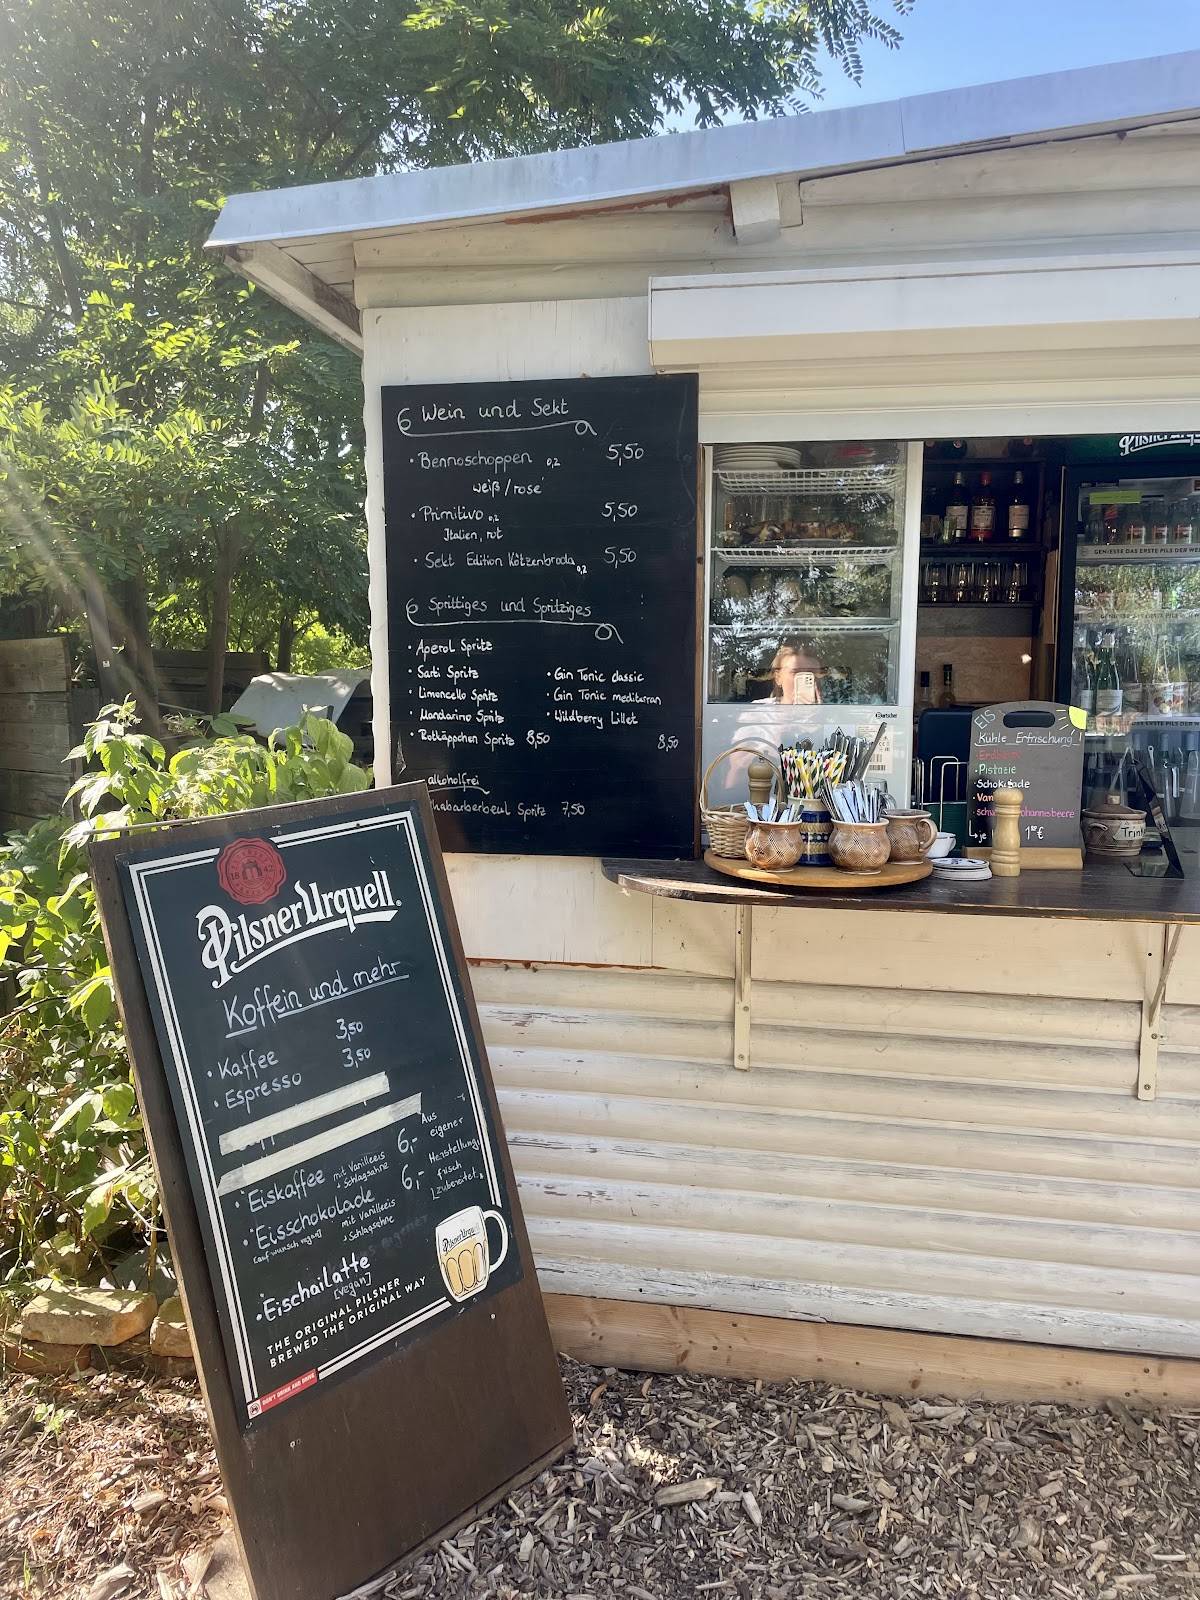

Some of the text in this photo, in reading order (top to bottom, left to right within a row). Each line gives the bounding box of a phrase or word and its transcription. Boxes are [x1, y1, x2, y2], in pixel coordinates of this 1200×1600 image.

[421, 398, 569, 422] Wein und Sekt
[417, 443, 645, 474] Bennoschoppen 0,2 5,50
[418, 505, 484, 522] Primitivo
[601, 502, 638, 522] 5,50
[443, 527, 503, 542] Italien, rot
[425, 552, 455, 568] Sekt
[466, 552, 503, 567] Edition
[603, 547, 637, 568] 5,50
[501, 598, 526, 613] und
[533, 597, 592, 621] Spritziges
[416, 638, 493, 662] Aperol Spritz
[447, 666, 480, 685] Spritz
[554, 667, 645, 683] Gin Tonic classic
[418, 685, 499, 707] Limoncello Spritz
[553, 686, 662, 706] Gin Tonic mediterran
[419, 708, 505, 727] Mandarino Spritz
[554, 709, 639, 730] Wildberry Lillet
[974, 709, 996, 730] EIS
[484, 731, 515, 752] Spritz
[526, 729, 551, 750] 8,50
[657, 733, 679, 752] 8,50
[978, 731, 1073, 748] Kühle Erfrischung
[979, 763, 1017, 775] Pistazie
[427, 772, 480, 792] alkoholfrei
[431, 799, 586, 822] habarberbeul Spritz 7,50
[1020, 807, 1076, 819] ohannisbeere
[978, 830, 988, 844] je
[195, 871, 396, 989] Pilsner Urquell
[222, 956, 401, 1030] Koffein und mehr
[217, 1018, 364, 1081] Kaffee 3,50
[225, 1048, 371, 1114] Espresso 3,50
[421, 1112, 437, 1125] Aus
[430, 1117, 464, 1138] eigener
[436, 1160, 463, 1181] frisch
[248, 1168, 326, 1213] Eiskaffee
[333, 1166, 347, 1182] mit
[255, 1186, 376, 1250] Eisschokolade
[341, 1215, 357, 1228] mit
[359, 1198, 396, 1221] Vanilleeis
[262, 1252, 371, 1322] Eischailatte
[266, 1277, 402, 1356] THE ORIGINAL PILSNER
[269, 1275, 427, 1369] BREWED THE ORIGINAL WAY
[276, 1386, 292, 1398] DRINK
[291, 1380, 302, 1390] AND
[301, 1372, 316, 1384] DRIVE
